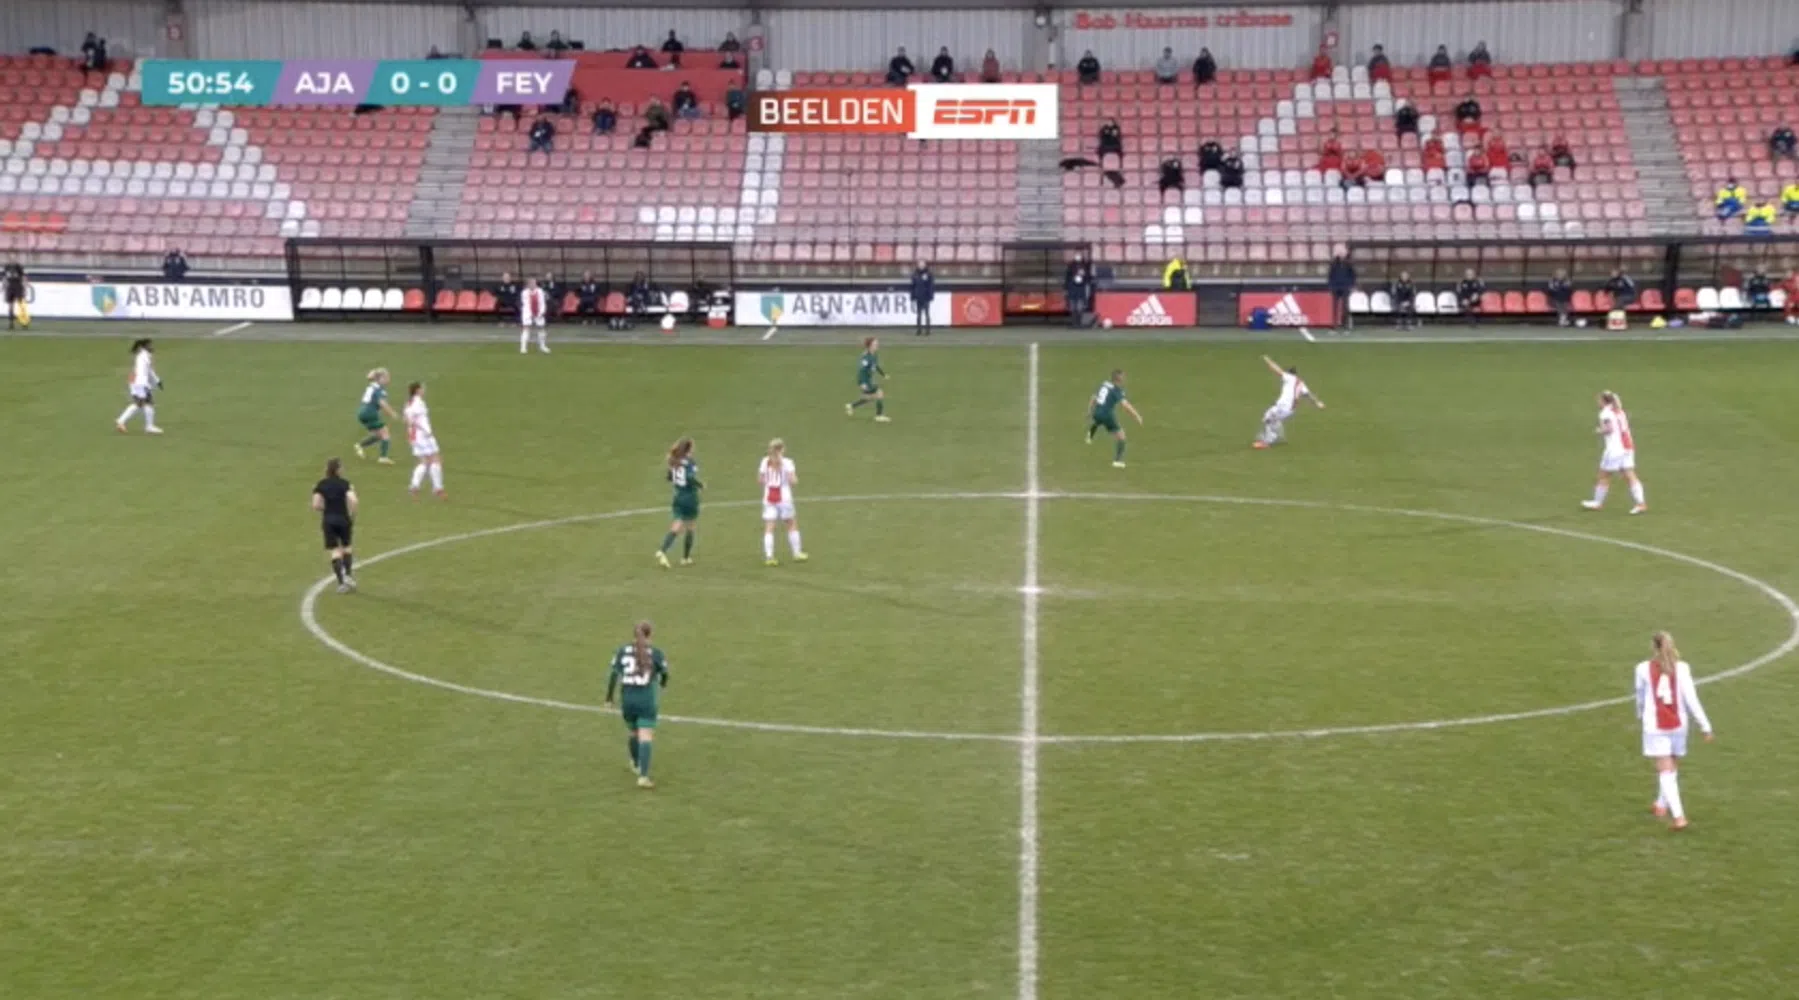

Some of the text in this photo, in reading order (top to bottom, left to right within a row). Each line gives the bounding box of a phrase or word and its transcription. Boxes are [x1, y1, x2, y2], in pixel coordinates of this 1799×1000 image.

[1075, 13, 1117, 29] Bob
[1126, 312, 1174, 327] adidas
[1656, 673, 1673, 705] 4
